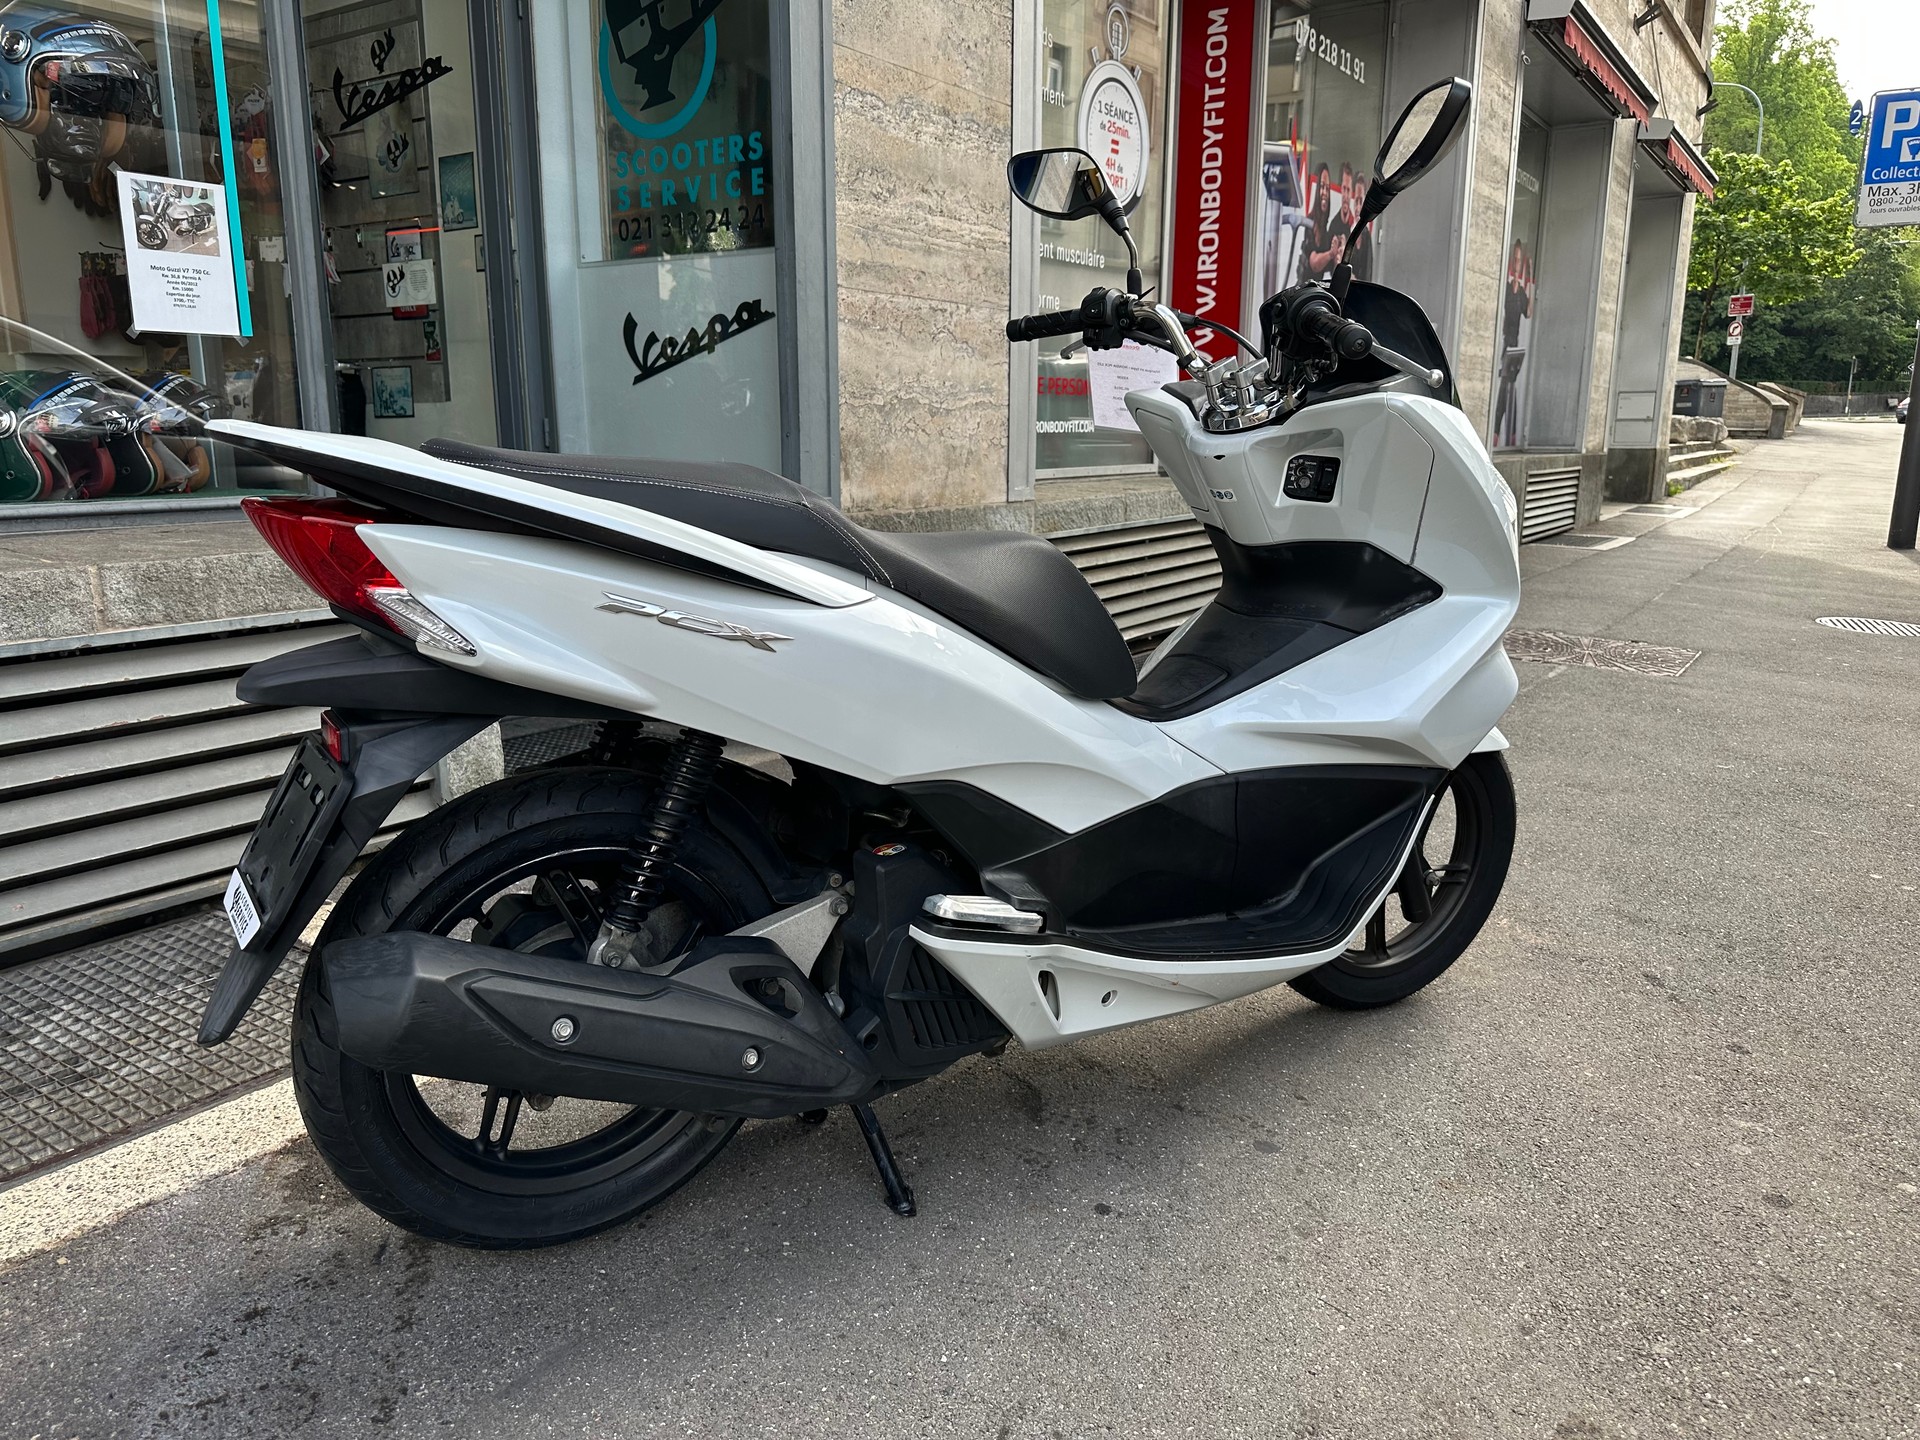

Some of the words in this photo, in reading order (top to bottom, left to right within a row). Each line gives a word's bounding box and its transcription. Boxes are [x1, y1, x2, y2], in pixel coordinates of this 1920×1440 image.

[1296, 19, 1317, 52] 078
[1318, 34, 1338, 66] 218
[1340, 48, 1351, 75] 11
[1353, 58, 1365, 84] 91
[333, 56, 454, 132] Vespa
[1104, 101, 1134, 125] SÉANCE
[1100, 120, 1106, 131] de
[1850, 109, 1862, 125] 2
[1881, 99, 1920, 149] P
[616, 131, 764, 178] SCOOTERS
[1105, 157, 1116, 171] 4H
[1117, 163, 1124, 174] de
[1871, 166, 1920, 180] Collect
[616, 167, 765, 212] SERVICE
[1194, 7, 1230, 362] WW.IRONBODYFIT.COM
[1867, 185, 1902, 197] Max.
[618, 217, 652, 242] 021
[705, 207, 732, 233] 24
[737, 204, 765, 231] 24
[1056, 246, 1105, 269] musculaire
[623, 299, 776, 385] Vespa
[594, 591, 795, 653] PCX
